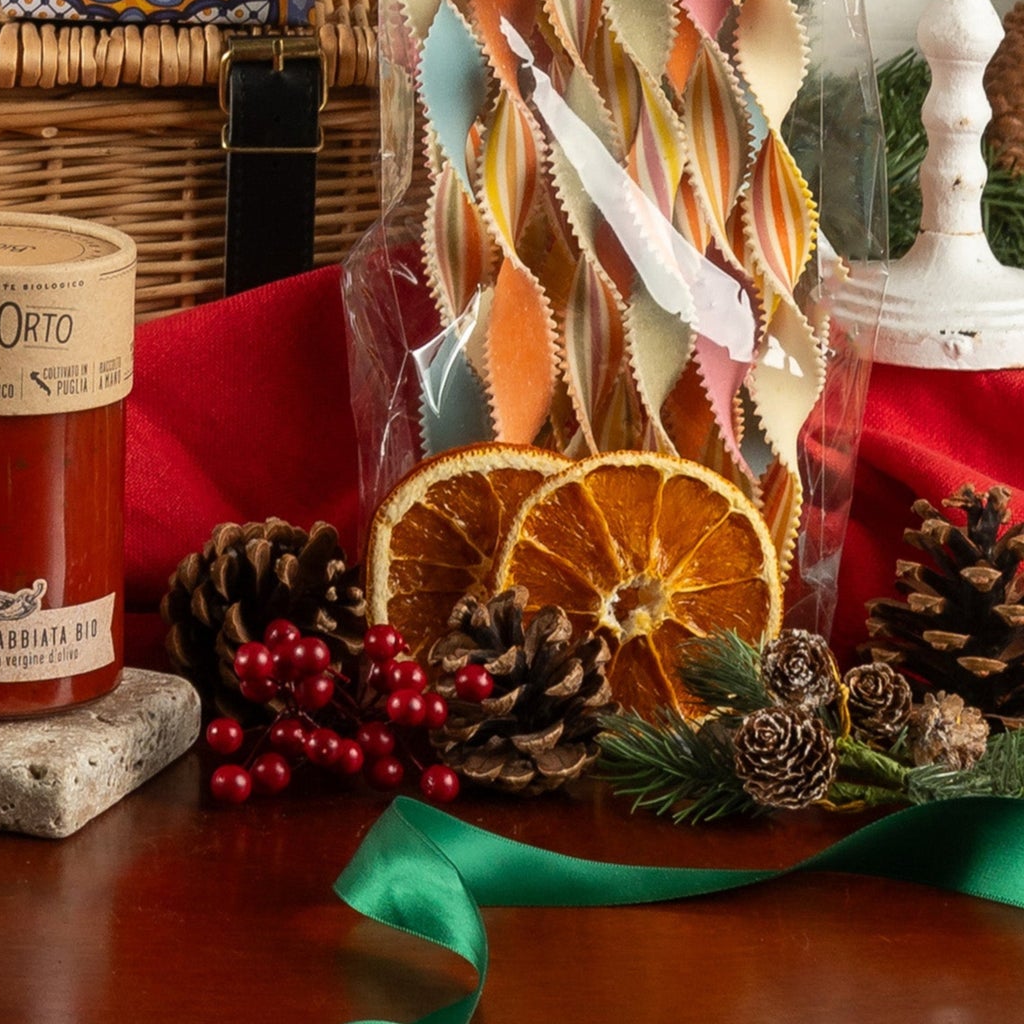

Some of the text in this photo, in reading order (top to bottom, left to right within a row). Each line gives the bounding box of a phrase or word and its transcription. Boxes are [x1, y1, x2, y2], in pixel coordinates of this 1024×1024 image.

[23, 280, 86, 291] BIOLOGICO
[43, 363, 88, 380] COLTIVATO IN
[57, 377, 88, 396] PUGLIA
[76, 618, 98, 642] BIO
[6, 652, 45, 670] vergine
